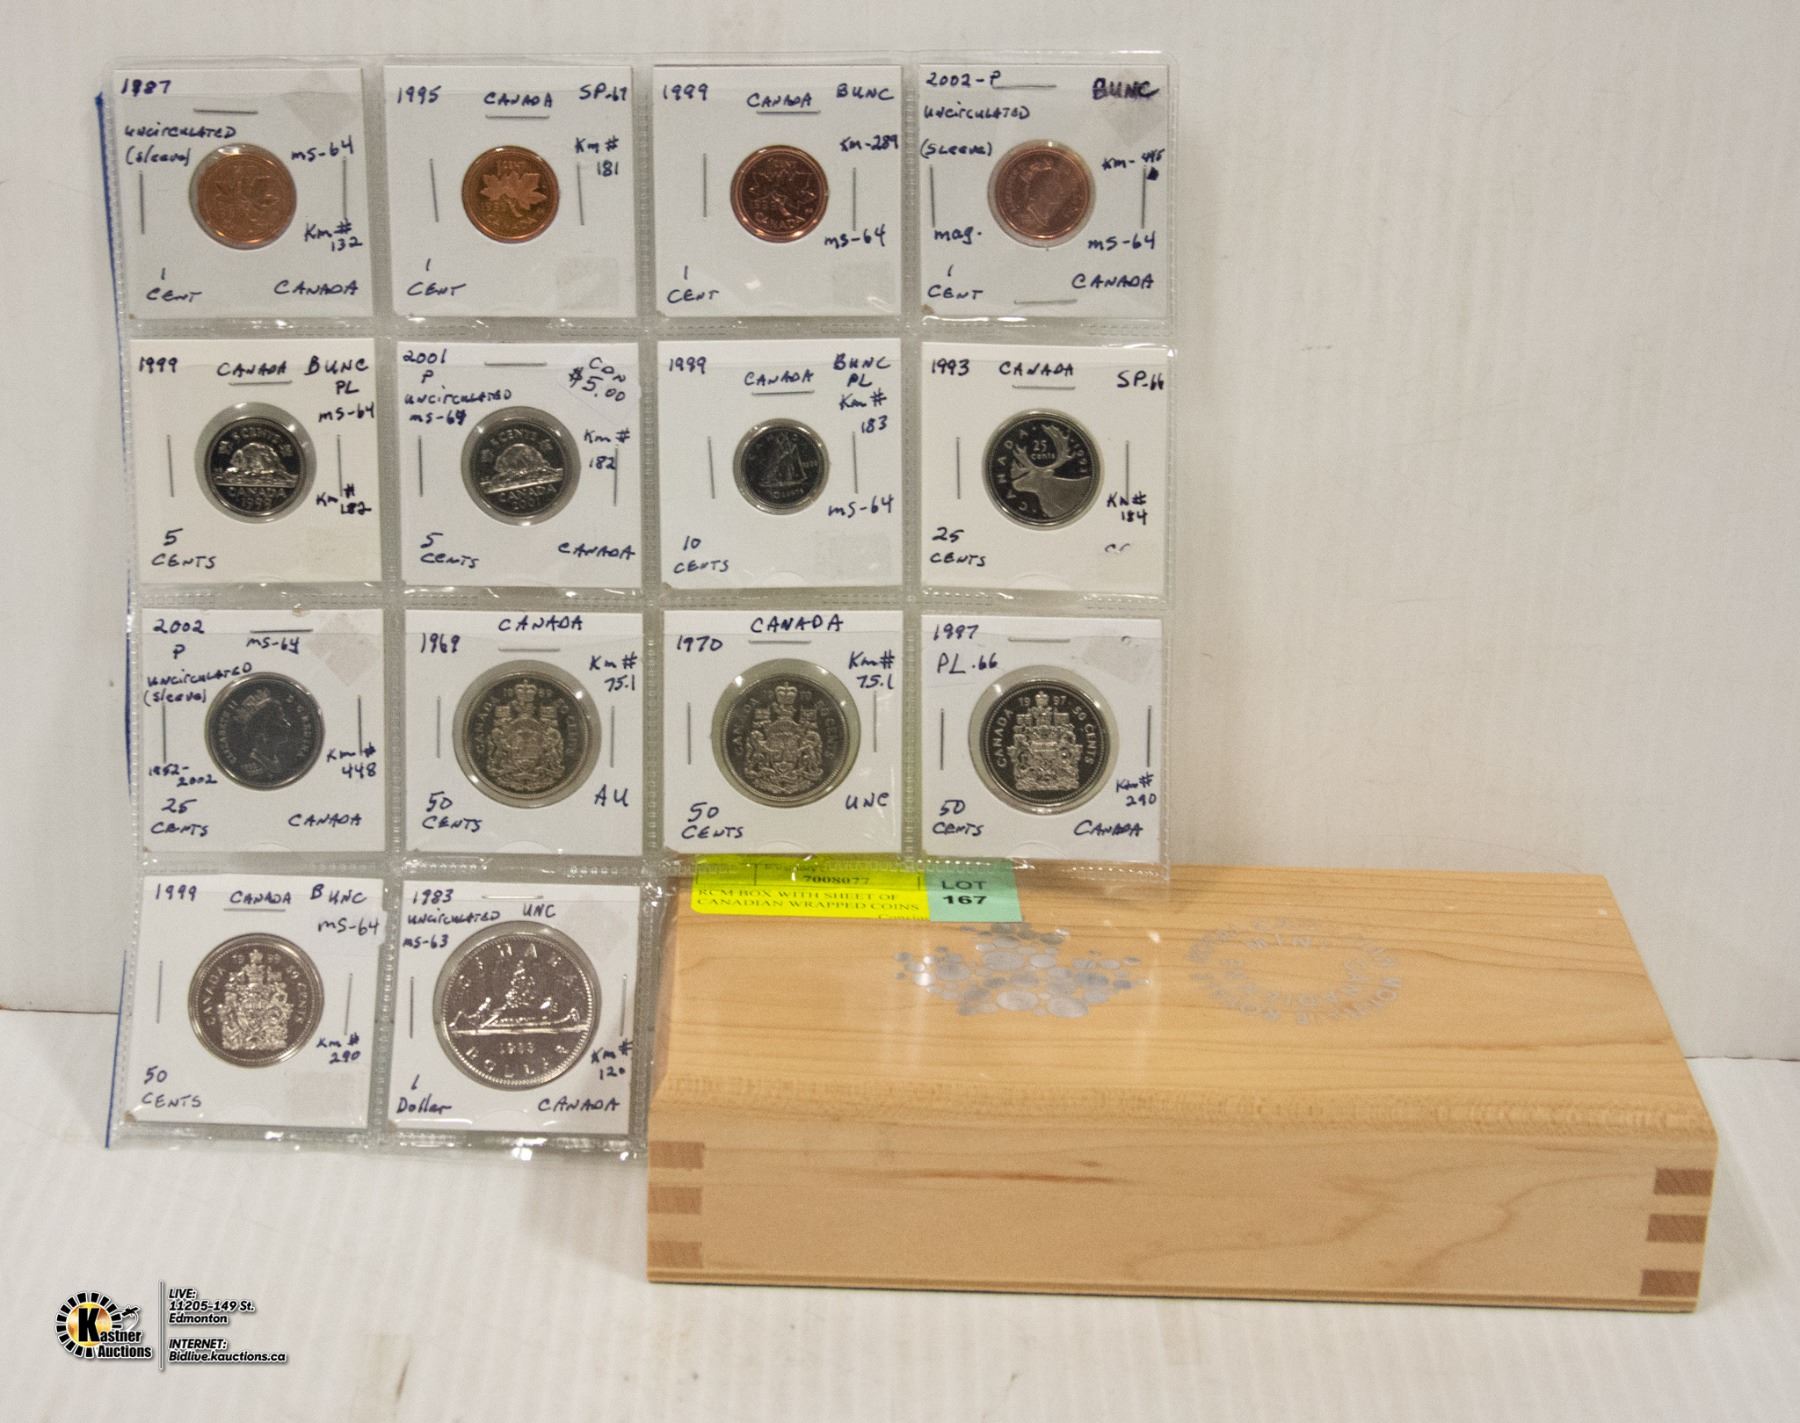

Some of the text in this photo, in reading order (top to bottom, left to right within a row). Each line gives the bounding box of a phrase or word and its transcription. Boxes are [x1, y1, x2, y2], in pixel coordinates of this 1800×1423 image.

[397, 85, 442, 104] 1995
[483, 92, 552, 107] CANADA
[663, 83, 894, 107] 1999 CANADA BUNC
[597, 160, 618, 176] 181
[331, 237, 362, 252] 132
[274, 280, 358, 296] CANADA
[1072, 273, 1154, 289] CANADA
[667, 289, 719, 303] CENT
[402, 349, 447, 364] 2001
[139, 355, 368, 377] 1999 CANADA BUNC
[932, 358, 970, 376] 1993
[999, 361, 1074, 376] CANADA
[421, 370, 434, 383] P
[744, 369, 814, 386] CANADA
[847, 373, 872, 387] PL
[336, 381, 359, 395] PL
[861, 415, 888, 433] 183
[1033, 440, 1047, 452] 25
[1121, 510, 1148, 525] 184
[163, 528, 183, 546] 5
[420, 532, 443, 549] 5
[932, 527, 964, 542] 25
[683, 536, 701, 550] 10
[558, 543, 635, 560] CANADA
[152, 553, 216, 569] CENTS
[673, 559, 729, 573] CENTS
[930, 553, 986, 567] CENTS
[153, 619, 205, 634] 2002
[498, 615, 583, 631] CANADA
[751, 614, 843, 633] CANADA
[421, 633, 460, 653] 1969
[677, 635, 723, 652] 1970
[173, 645, 185, 659] P
[604, 676, 636, 692] 75.1
[857, 674, 894, 689] 75.1
[342, 763, 376, 778] 448
[177, 775, 217, 787] 2002
[162, 798, 197, 813] 25
[426, 791, 453, 812] 50
[845, 792, 889, 810] UNC
[939, 799, 965, 816] 50
[1126, 794, 1157, 807] 290
[288, 813, 362, 827] CANADA
[688, 801, 719, 823] 50
[422, 816, 482, 832] CENTS
[681, 825, 743, 839] CENTS
[942, 880, 987, 890] LOT
[155, 884, 197, 901] 1999
[230, 891, 291, 904] CANADA
[413, 889, 454, 905] 1983
[943, 896, 987, 904] 167
[522, 904, 556, 918] UNC
[789, 901, 866, 909] WRAPPED
[871, 903, 920, 911] COINS
[329, 1050, 360, 1064] 290
[144, 1066, 167, 1084] 50
[142, 1092, 201, 1108] CENTS
[397, 1094, 452, 1113] Dollar
[538, 1096, 620, 1112] CANADA
